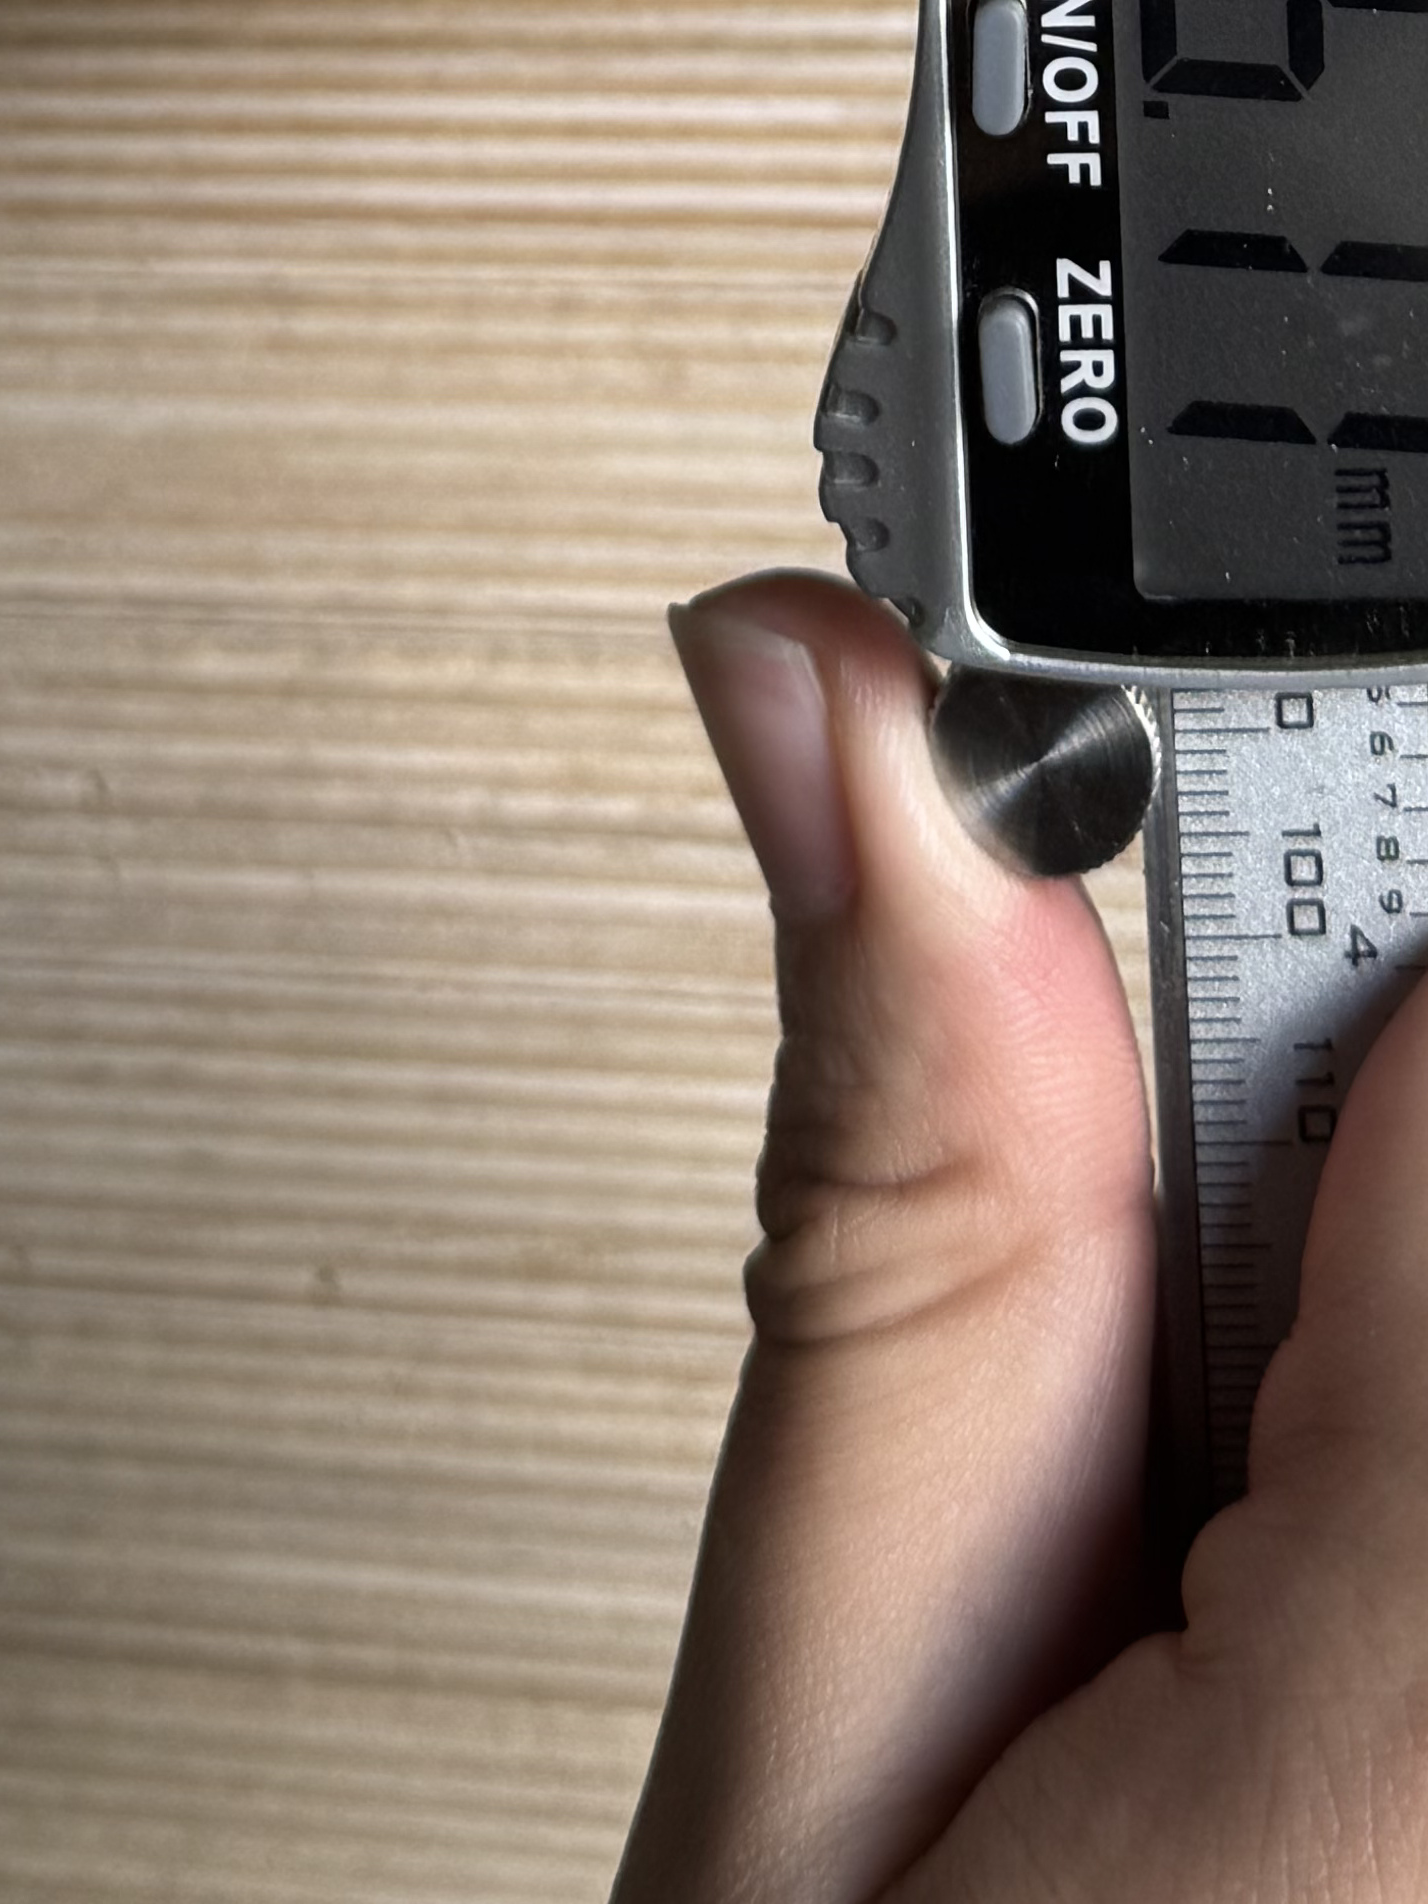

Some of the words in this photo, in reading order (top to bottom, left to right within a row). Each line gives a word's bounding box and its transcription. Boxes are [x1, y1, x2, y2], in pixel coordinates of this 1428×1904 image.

[1056, 257, 1119, 446] ZERO
[1335, 467, 1393, 566] mm
[1369, 731, 1396, 759] 6
[1372, 782, 1399, 811] 7
[1375, 834, 1401, 864] 8
[1281, 822, 1328, 940] 100
[1378, 889, 1404, 917] 9
[1344, 923, 1378, 970] 4
[1294, 1037, 1338, 1148] 110
